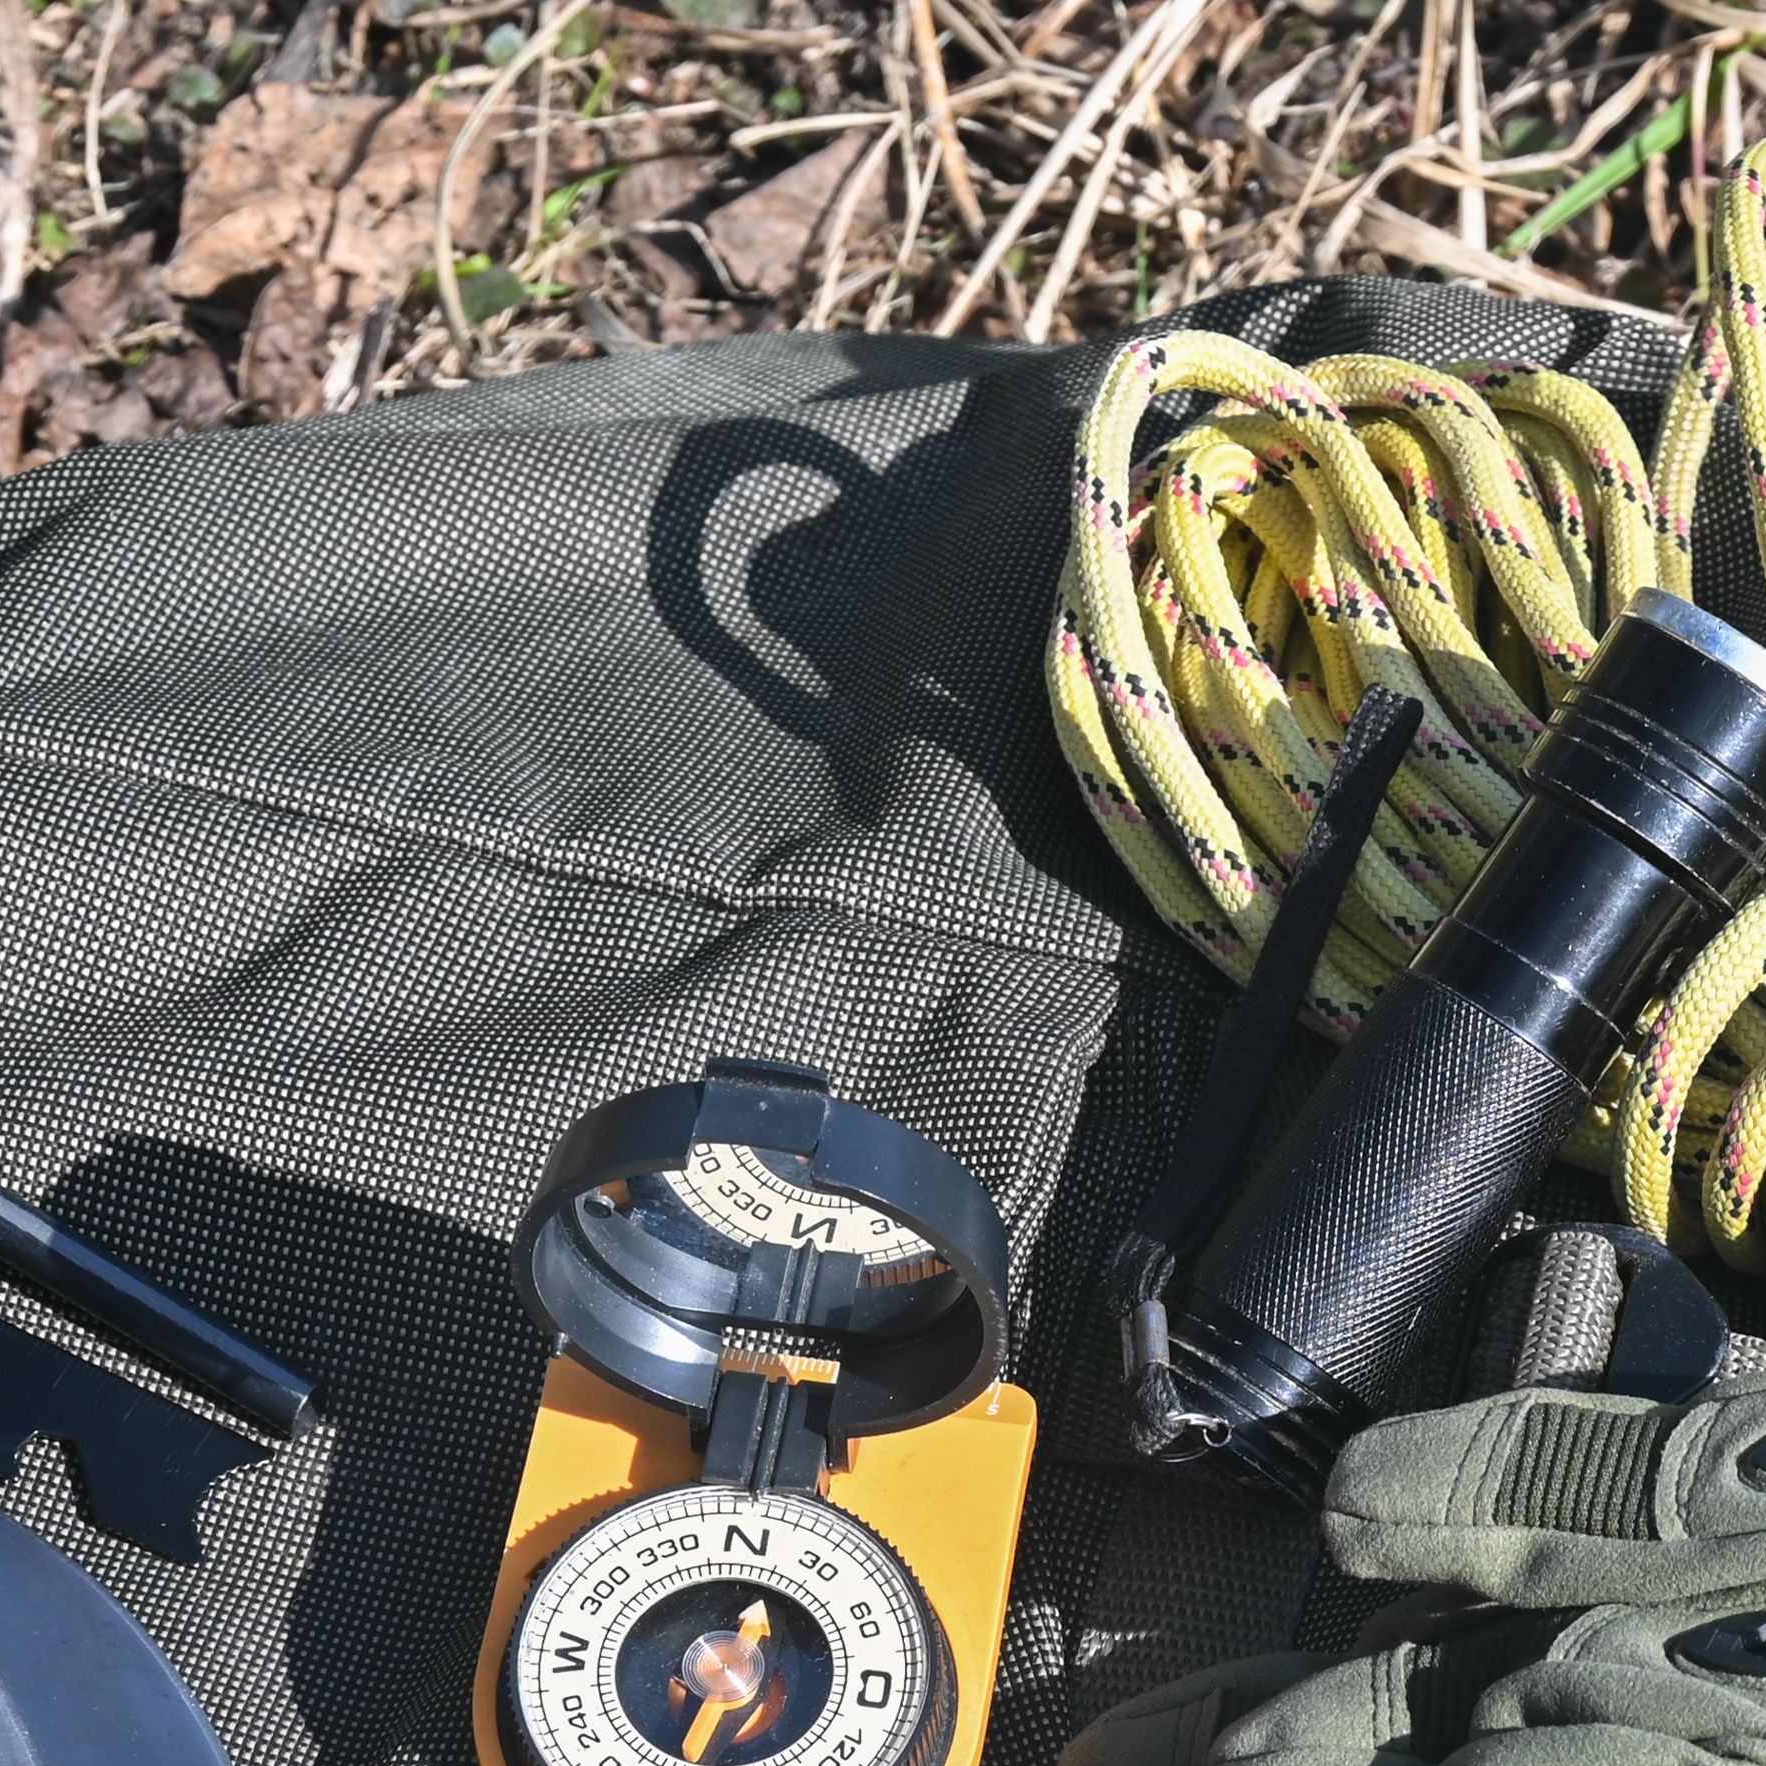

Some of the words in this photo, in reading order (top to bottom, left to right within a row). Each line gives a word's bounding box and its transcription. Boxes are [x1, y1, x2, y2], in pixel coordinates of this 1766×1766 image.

[636, 1534, 700, 1567] 330
[723, 1524, 770, 1557] N
[798, 1550, 839, 1582] 30
[579, 1566, 631, 1616] 300
[849, 1601, 881, 1639] 60
[552, 1631, 590, 1674] W
[562, 1695, 601, 1749] 240
